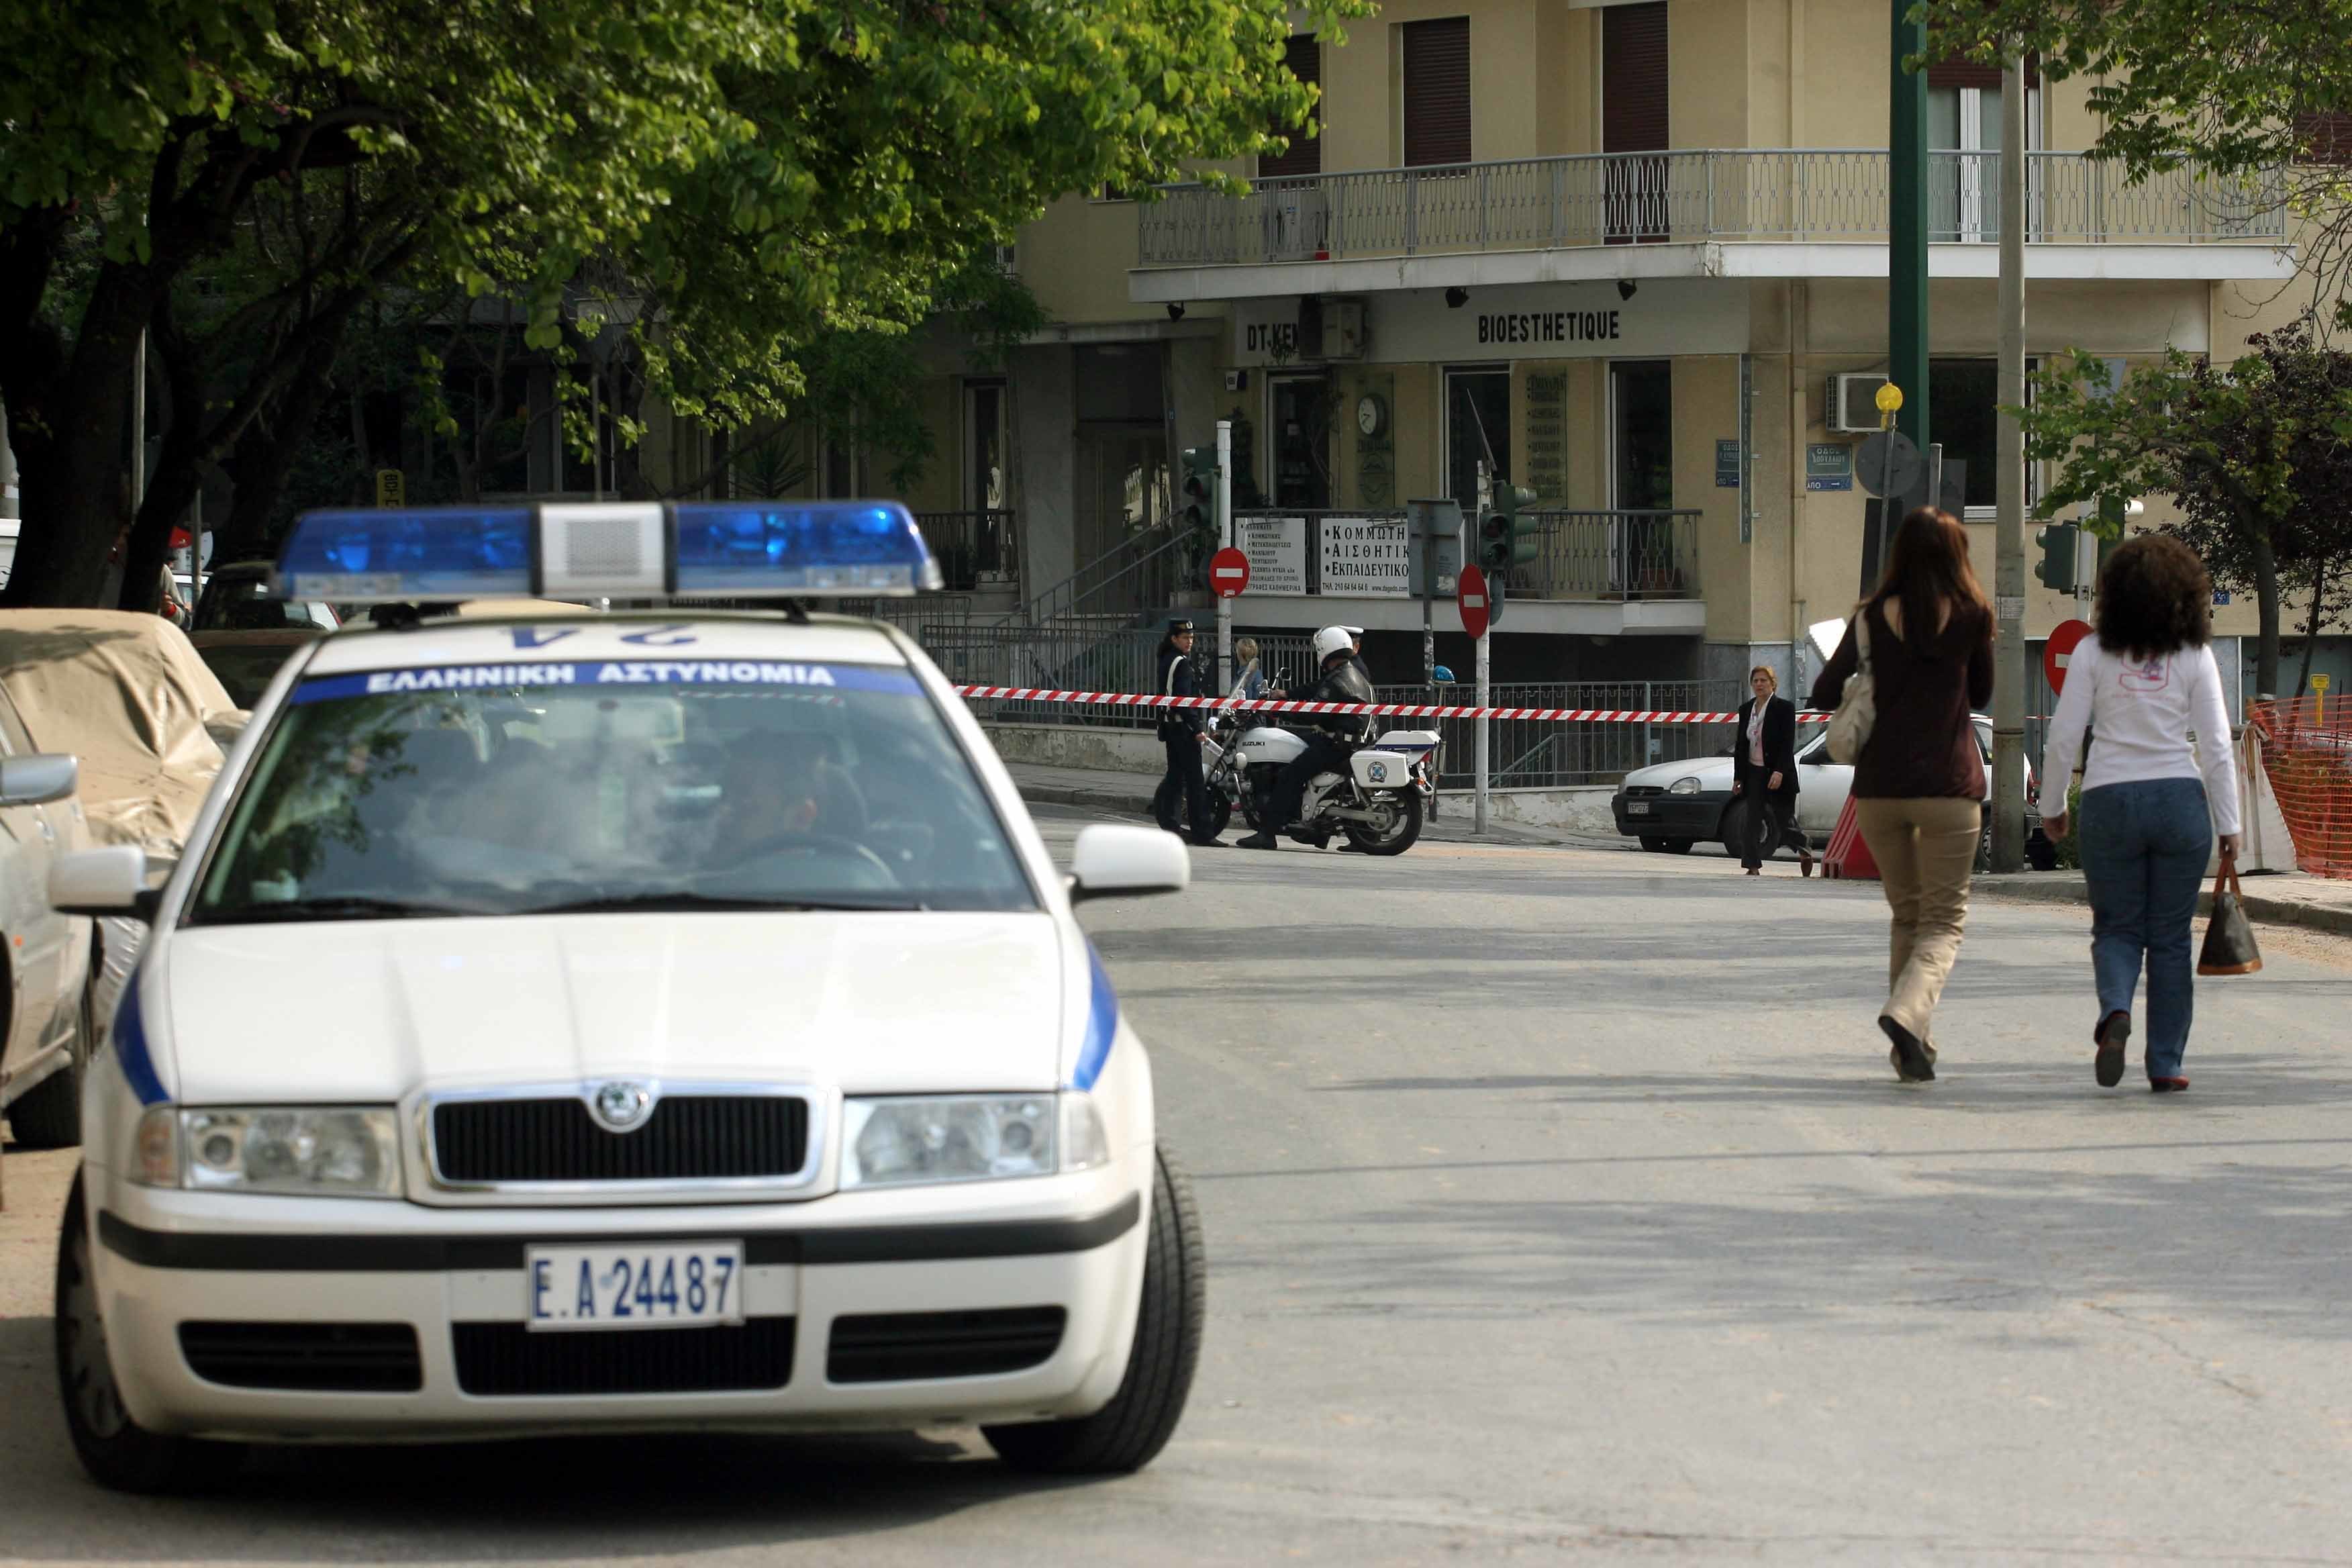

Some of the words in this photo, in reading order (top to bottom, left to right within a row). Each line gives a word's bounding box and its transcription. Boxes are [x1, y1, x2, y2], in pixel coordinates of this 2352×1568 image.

[1478, 311, 1619, 343] BIOESTHETIQUE
[366, 664, 576, 693] ΕΛΛΗΝΙΚΗ
[598, 662, 836, 686] ΑΣΤΥΝΟΜΙΑ
[611, 1256, 734, 1317] 24487
